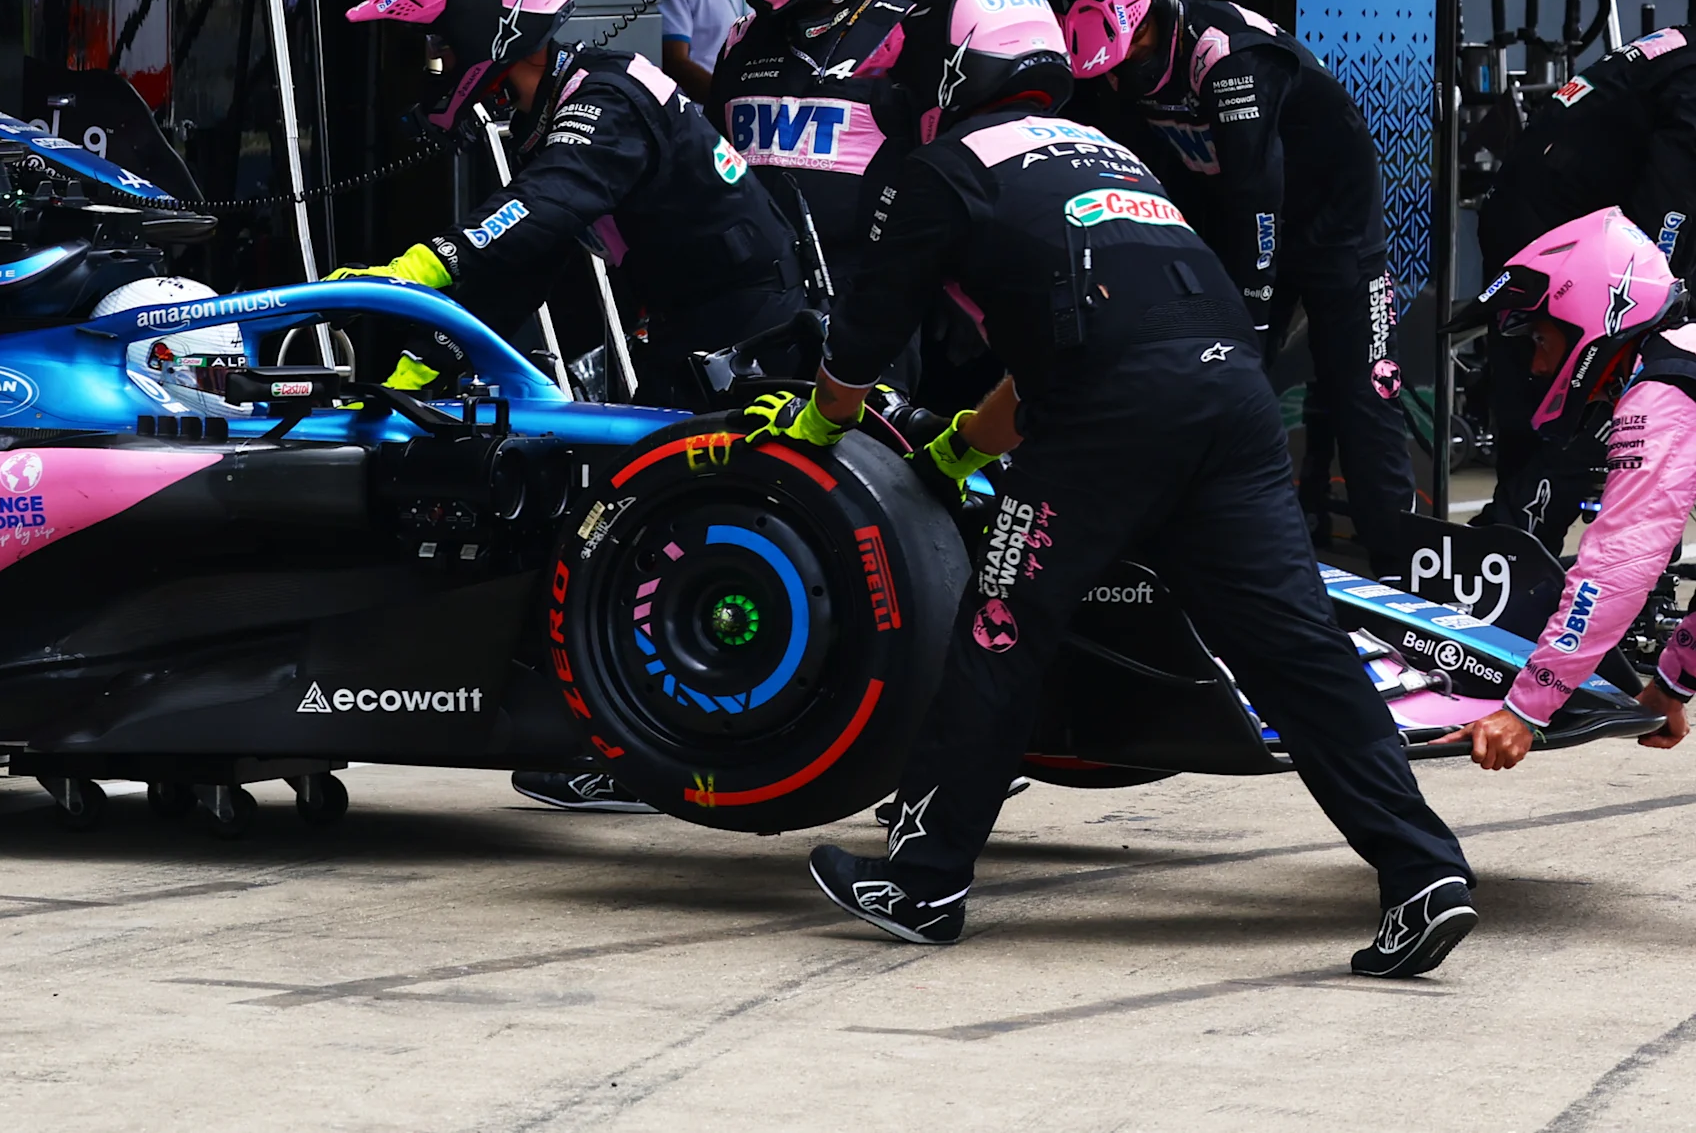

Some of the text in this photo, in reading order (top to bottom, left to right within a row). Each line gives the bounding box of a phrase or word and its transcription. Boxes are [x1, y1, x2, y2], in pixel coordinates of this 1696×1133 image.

[1116, 6, 1128, 26] BWT
[745, 56, 785, 66] ALPINE
[747, 70, 780, 79] BINANCE
[557, 103, 603, 116] BILIZE
[1224, 93, 1256, 106] ecowatt
[560, 120, 595, 134] cowatt
[1218, 106, 1260, 123] PIRELLI
[731, 101, 847, 156] BWT
[1054, 125, 1112, 147] BW
[745, 154, 836, 169] TER TECHNOLOGY
[1021, 143, 1147, 170] ALPIN
[1099, 158, 1145, 176] TEAM
[481, 198, 530, 240] BWT
[1105, 192, 1186, 225] Castro
[1256, 212, 1275, 254] BWT
[1657, 228, 1679, 264] BW
[1243, 287, 1261, 298] Bell
[1486, 271, 1511, 296] BWT
[136, 290, 287, 330] amazon music
[1369, 278, 1382, 361] CHANGE
[1378, 275, 1390, 342] WORLD
[211, 356, 247, 367] ALP
[1575, 344, 1599, 381] BINANCE
[280, 382, 310, 396] Castrol
[1610, 414, 1648, 429] BILIZE
[1609, 438, 1645, 451] cowatt
[14, 522, 31, 546] by
[34, 526, 55, 539] sip
[984, 494, 1019, 598] CHANGE
[997, 503, 1035, 586] WORLD
[1023, 552, 1044, 580] sip
[1035, 501, 1058, 528] sip
[854, 524, 902, 632] PIRELLI
[1410, 535, 1511, 626] plug
[1088, 580, 1154, 605] rosoft
[1565, 579, 1601, 636] BWT
[549, 559, 625, 760] P ZERO
[1402, 630, 1437, 656] Bell
[1463, 656, 1504, 685] Ross
[333, 687, 483, 712] ecowatt
